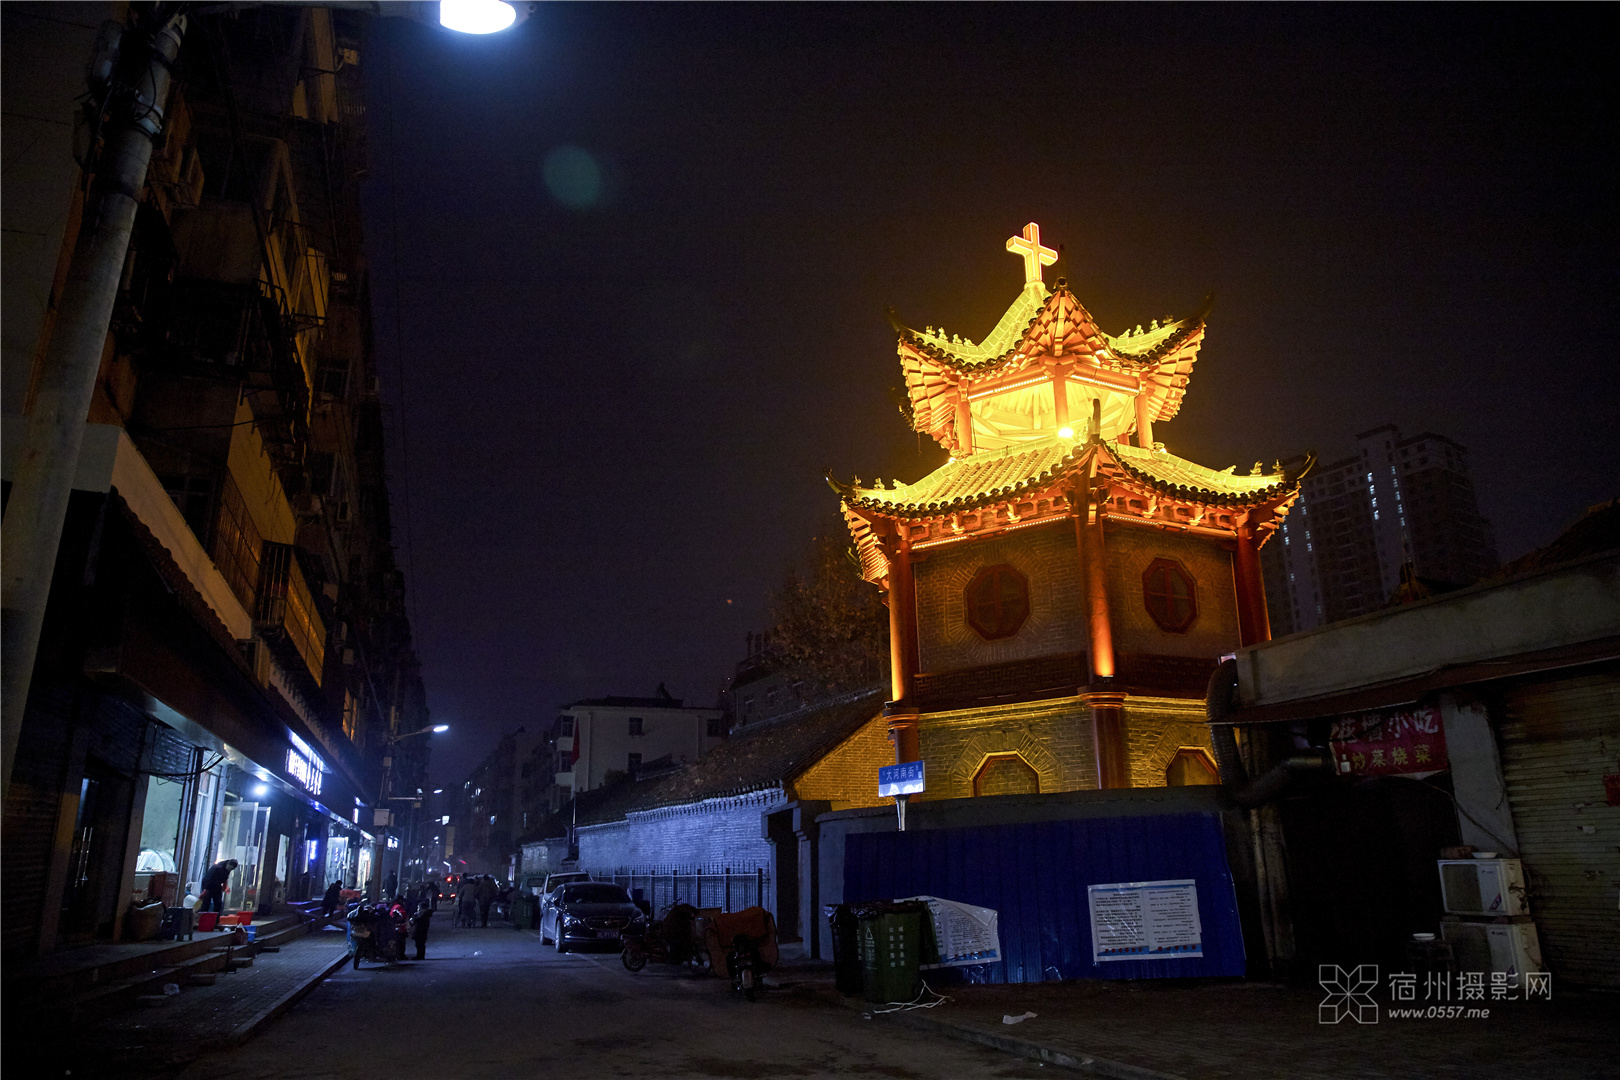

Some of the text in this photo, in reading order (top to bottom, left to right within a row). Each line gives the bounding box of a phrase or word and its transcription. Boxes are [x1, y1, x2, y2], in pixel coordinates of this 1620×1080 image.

[1352, 744, 1432, 769] 炒菜烧菜
[886, 766, 915, 781] 大河南街
